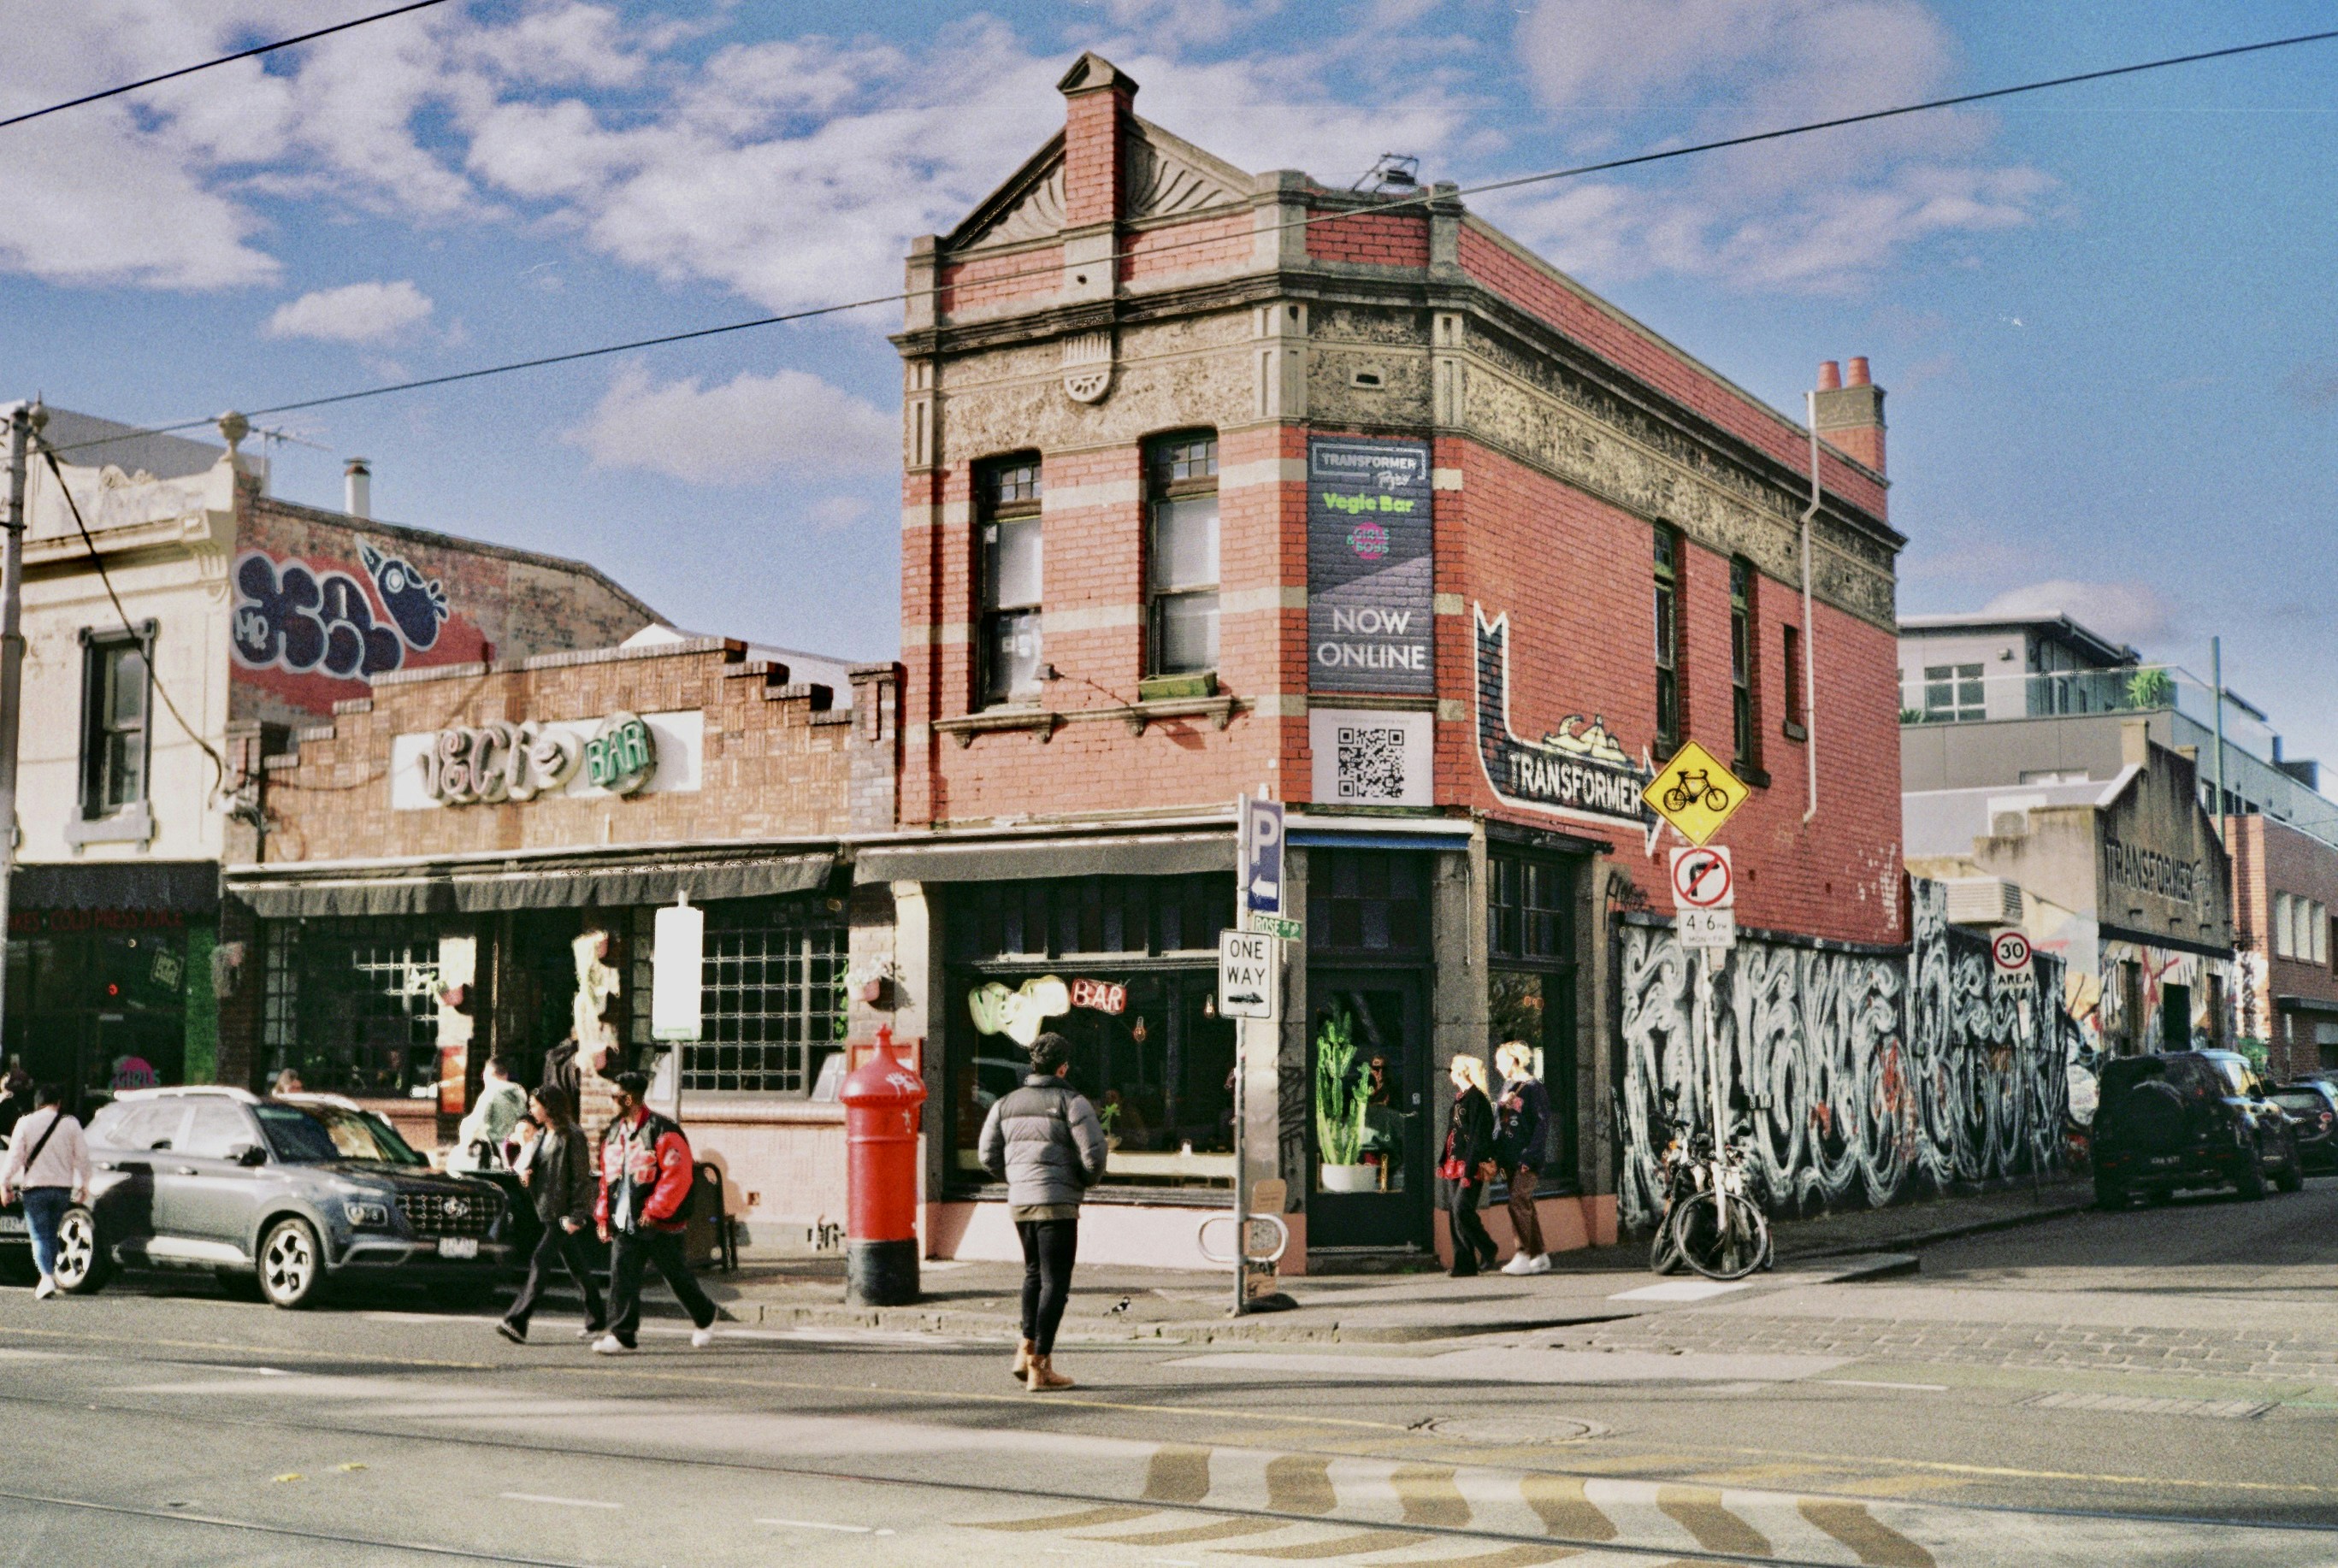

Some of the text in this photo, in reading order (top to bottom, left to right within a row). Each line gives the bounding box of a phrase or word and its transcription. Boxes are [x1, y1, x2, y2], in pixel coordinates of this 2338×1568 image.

[1321, 452, 1417, 469] TRANSFORMER
[1322, 492, 1414, 515] Vegie Bar
[1354, 528, 1390, 541] GIRLS
[1355, 541, 1390, 554] BOYS
[1332, 608, 1411, 635] NOW
[1316, 641, 1426, 670] ONLINE
[585, 721, 650, 787] BAR
[1507, 750, 1643, 816] TRANSFORMER
[1250, 808, 1280, 867] P
[2105, 836, 2193, 905] TRANSFORMER
[1255, 917, 1281, 937] ROSE
[1230, 939, 1264, 960] ONE
[2000, 942, 2025, 960] 30
[1226, 965, 1266, 986] WAY
[1997, 972, 2033, 987] AREA
[1072, 980, 1124, 1011] BAR
